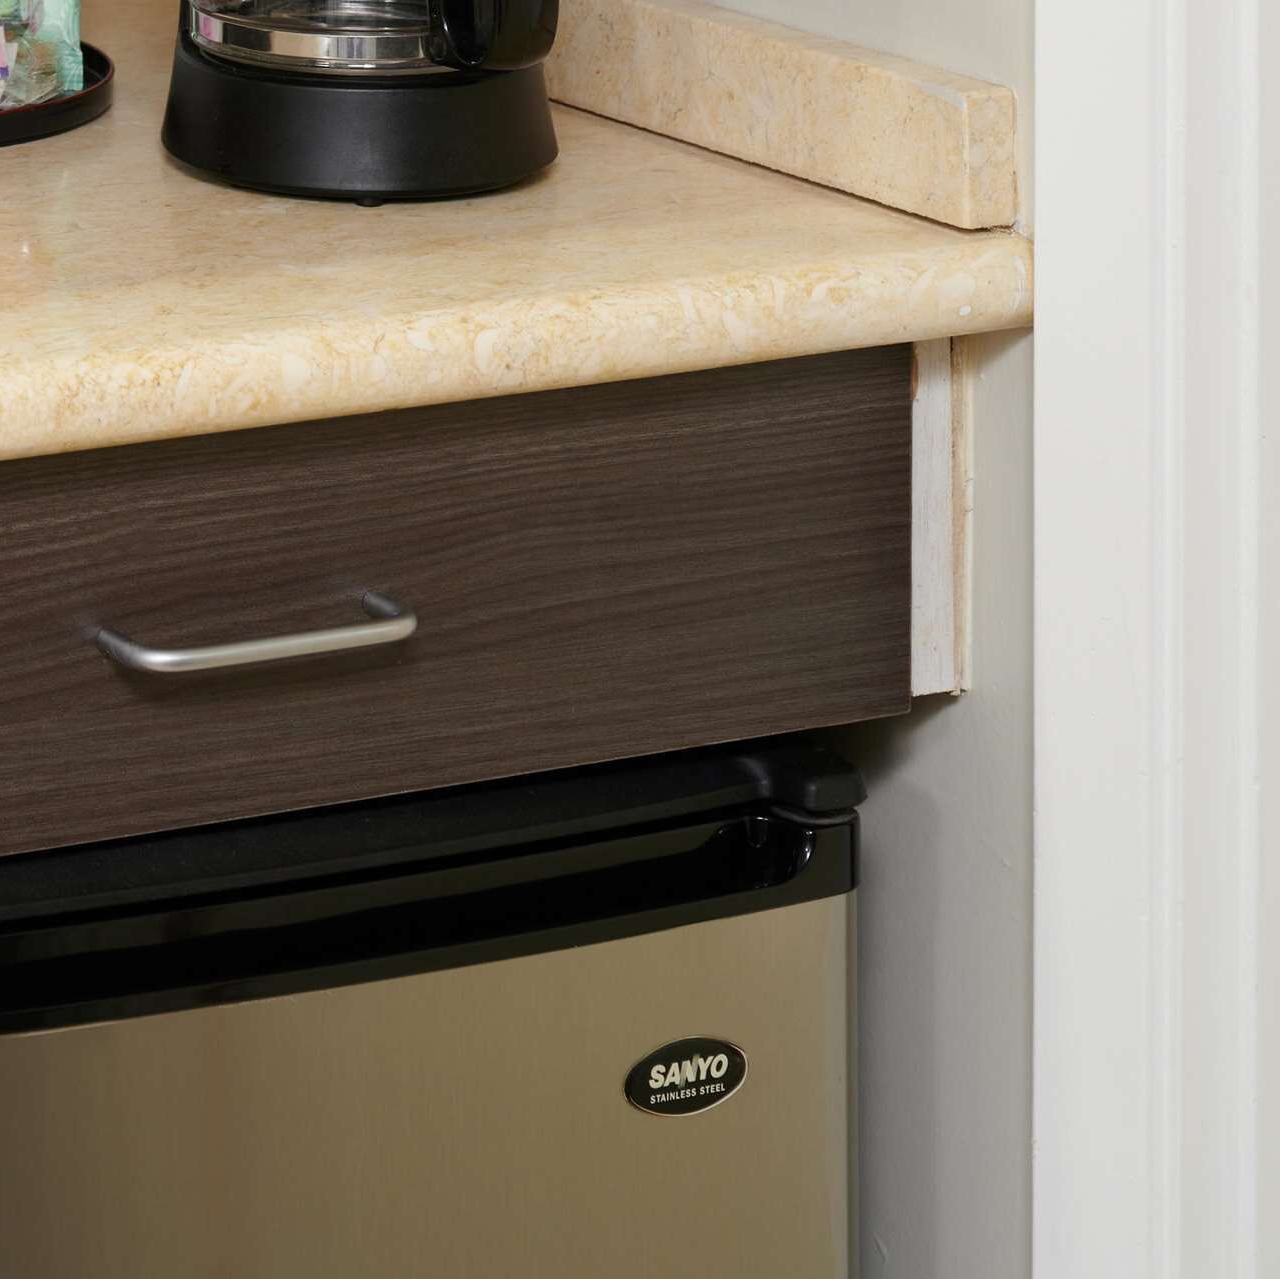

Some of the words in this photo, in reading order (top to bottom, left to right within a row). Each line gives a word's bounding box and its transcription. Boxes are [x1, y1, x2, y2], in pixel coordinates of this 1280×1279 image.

[648, 1053, 729, 1089] SANYO
[649, 1087, 697, 1105] STAINLESS
[699, 1082, 726, 1095] STEEL
